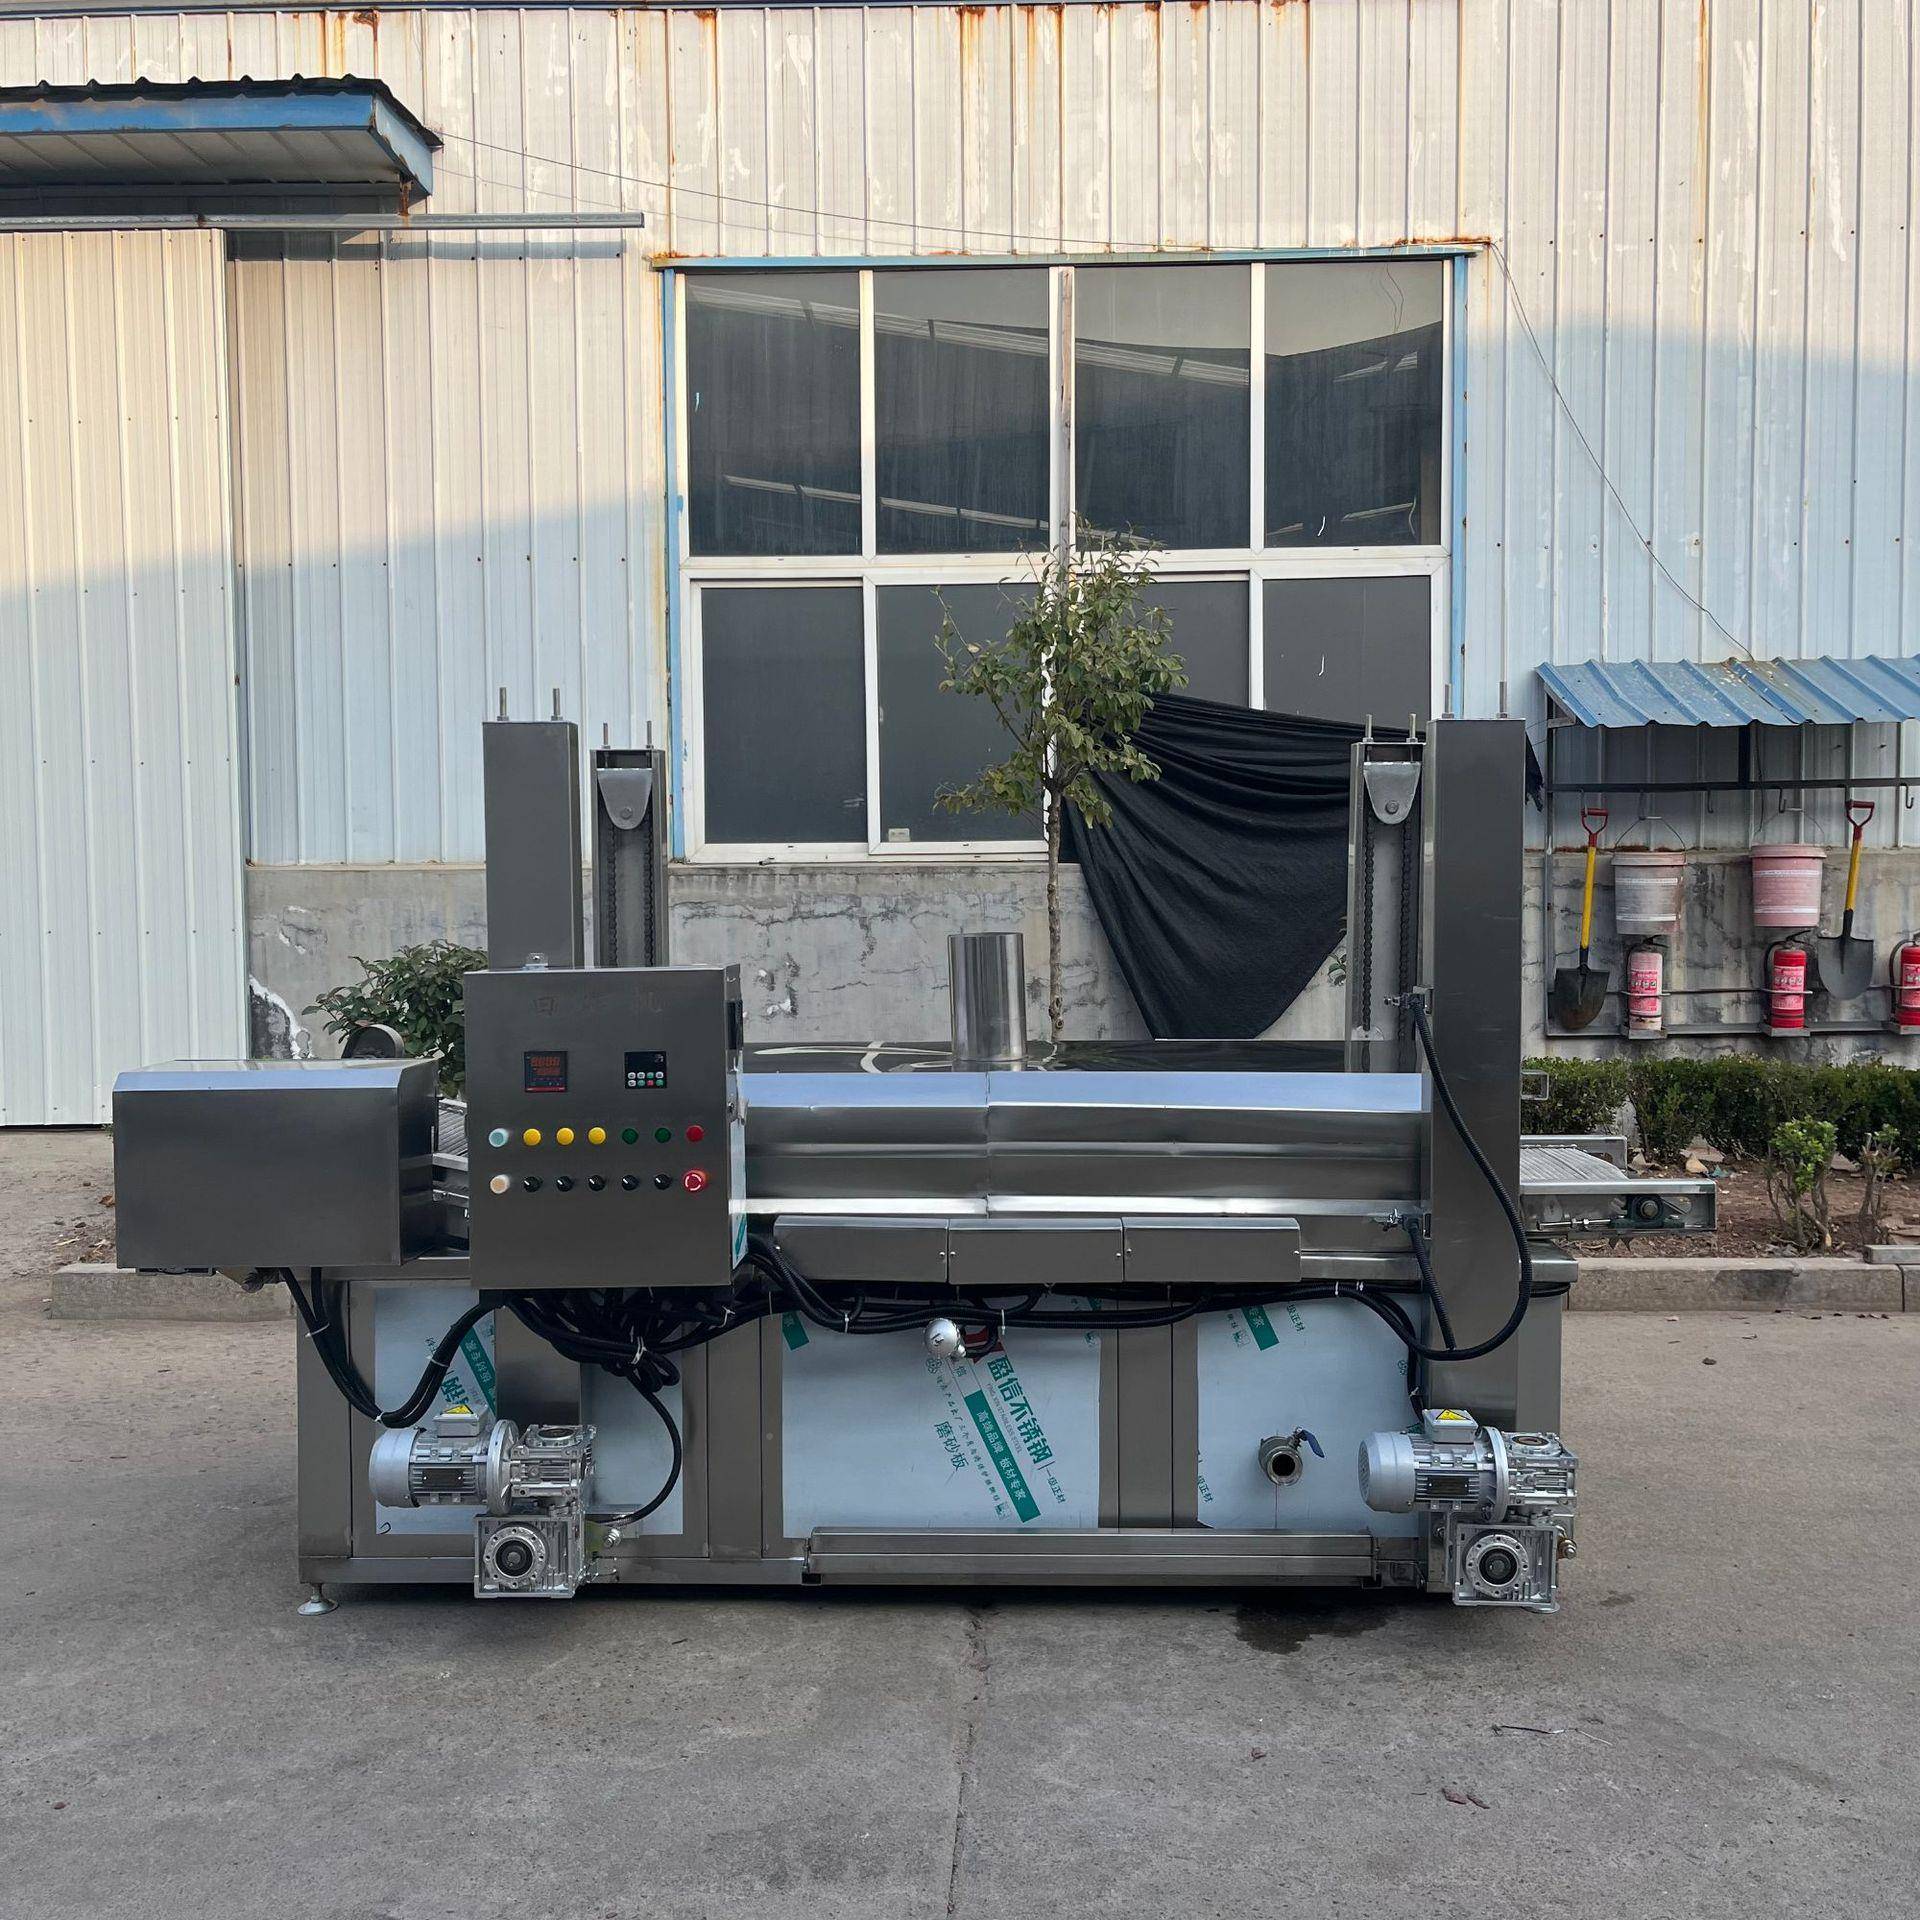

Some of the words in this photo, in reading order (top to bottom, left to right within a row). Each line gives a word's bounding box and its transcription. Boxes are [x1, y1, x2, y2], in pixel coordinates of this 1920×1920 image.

[934, 1421, 970, 1472] 磨砂板
[986, 1355, 1053, 1464] 盈信不锈钢
[976, 1410, 1005, 1454] 高端品牌
[1000, 1456, 1027, 1500] 板材专家
